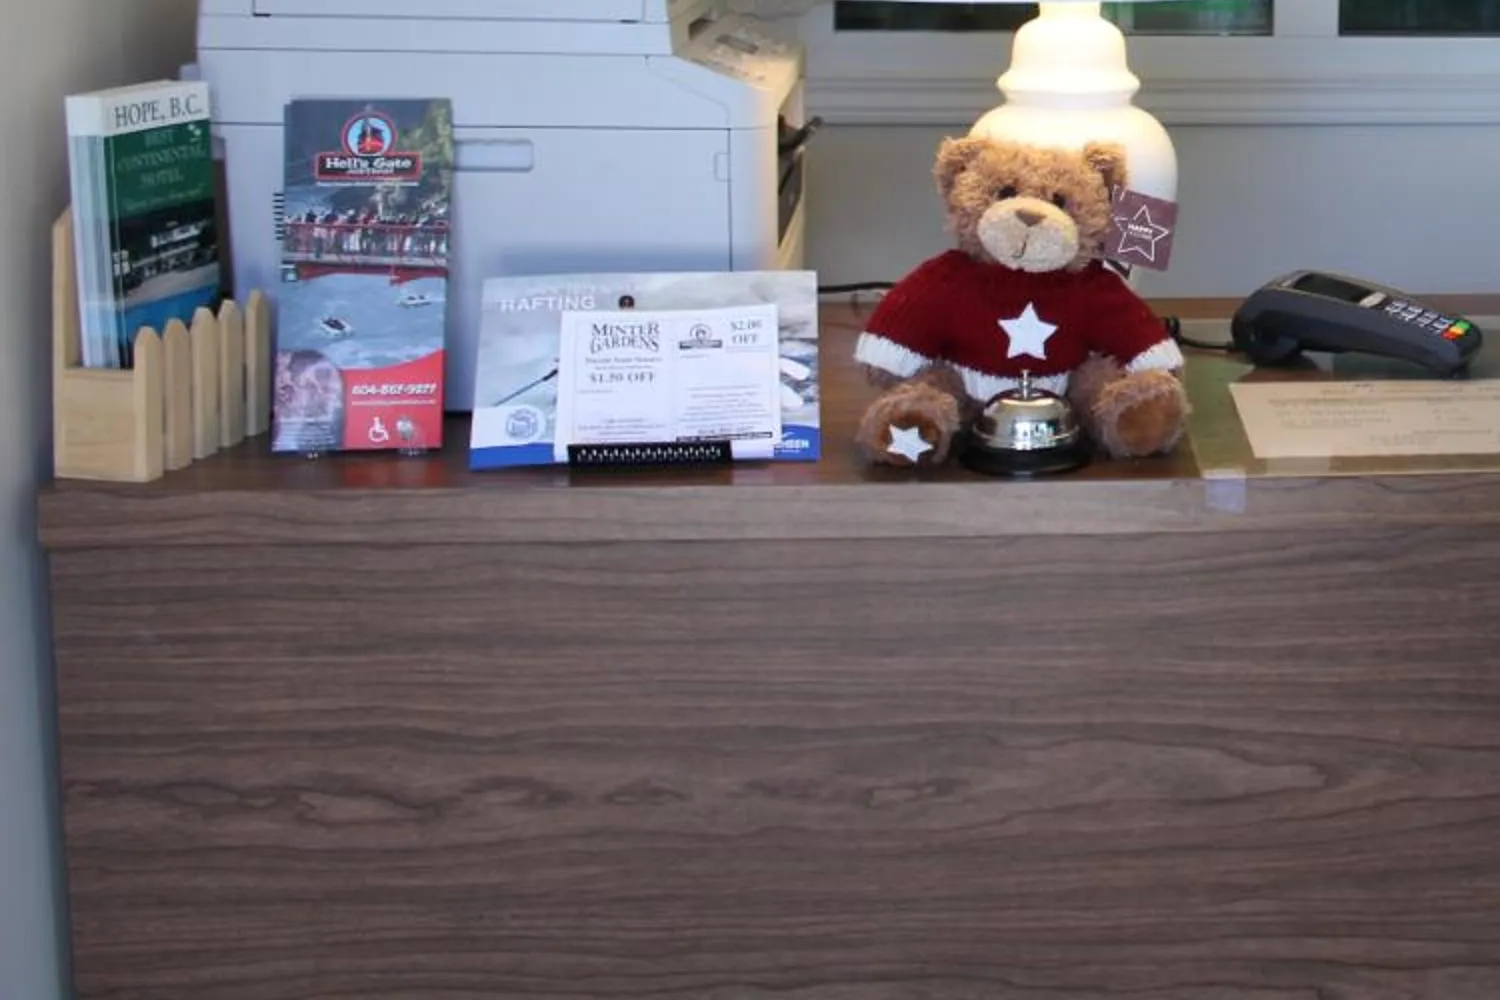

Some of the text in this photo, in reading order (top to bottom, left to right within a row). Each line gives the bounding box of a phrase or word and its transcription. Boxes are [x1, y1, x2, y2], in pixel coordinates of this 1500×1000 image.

[325, 157, 412, 169] Hell's Gate
[591, 322, 660, 337] MINTER
[590, 335, 660, 355] GARDENS
